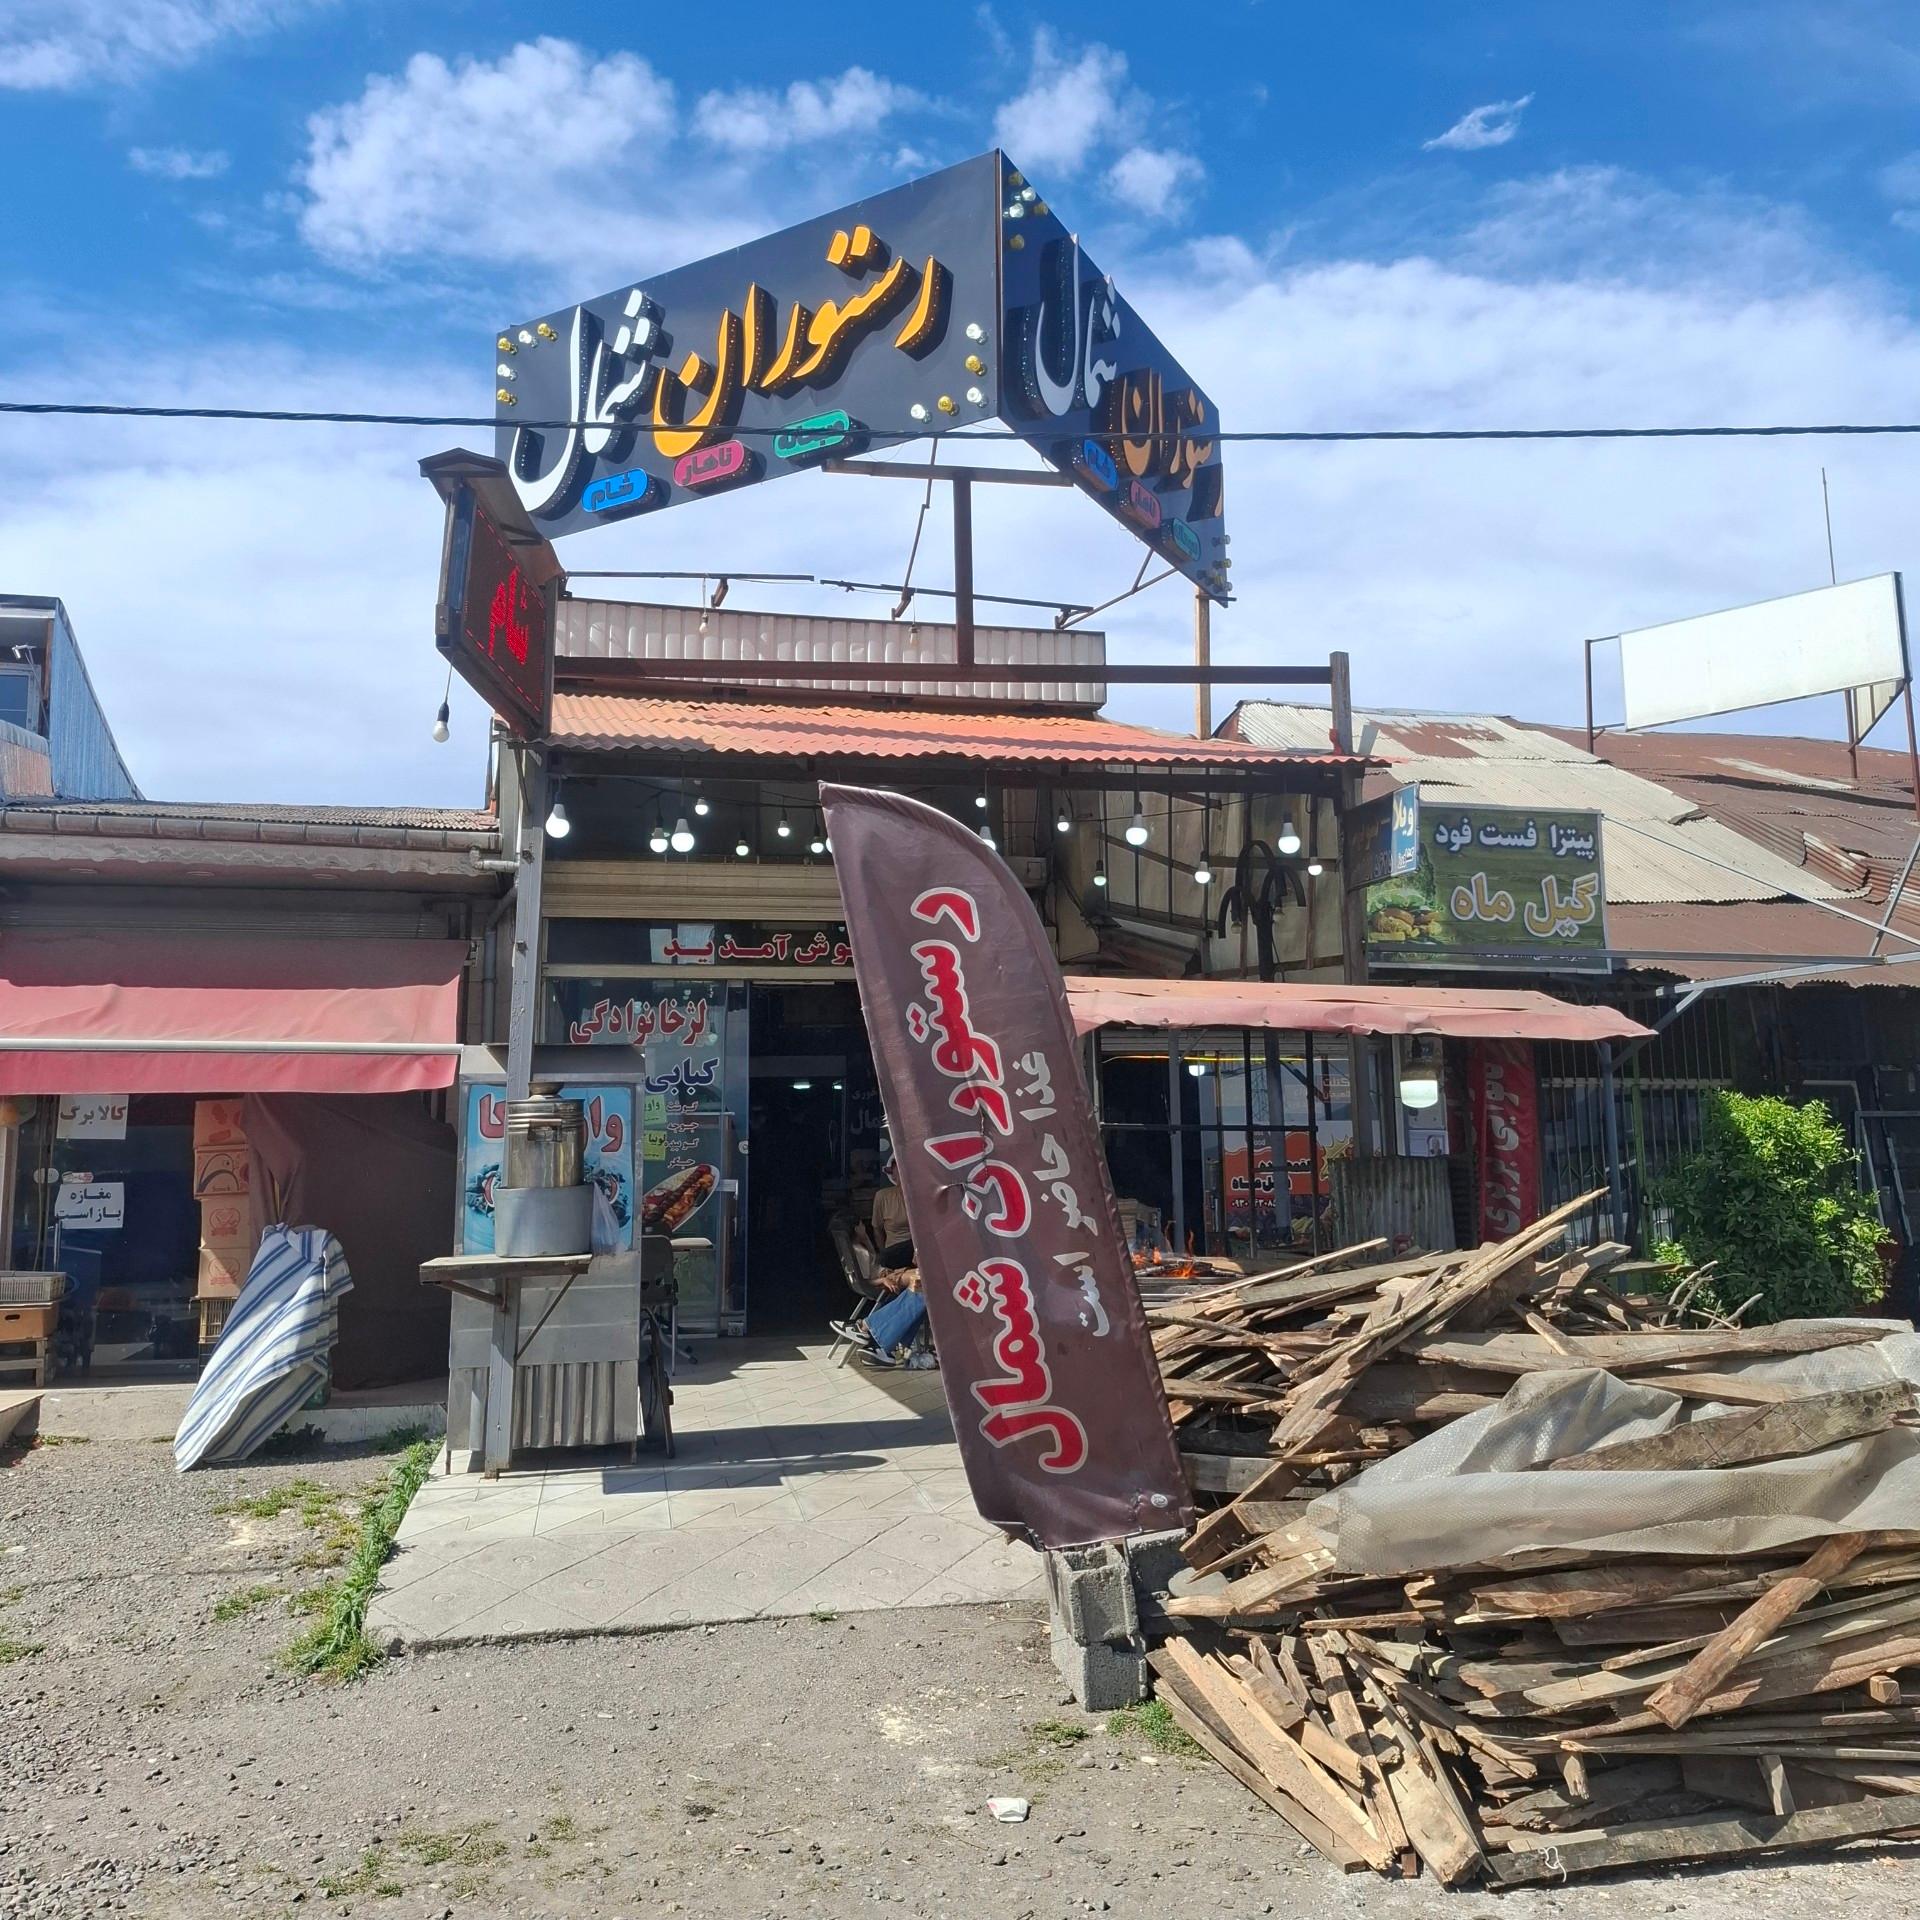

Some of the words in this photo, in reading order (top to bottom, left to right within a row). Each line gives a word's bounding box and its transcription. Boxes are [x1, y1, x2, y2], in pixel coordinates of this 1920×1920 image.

[653, 224, 936, 459] رستوران
[1035, 233, 1121, 417] شمال
[508, 287, 652, 514] شمال
[681, 446, 733, 485] ناهار
[590, 471, 634, 511] شام
[1435, 817, 1473, 851] فود
[1479, 820, 1538, 848] فست
[1551, 824, 1595, 860] پیتزا
[1450, 871, 1516, 922] ماه
[1524, 872, 1599, 938] گیل
[794, 931, 854, 966] وش
[644, 1056, 720, 1096] کبابی
[906, 886, 1032, 1237] رستوران
[1012, 1051, 1058, 1122] غذا
[98, 1105, 127, 1121] کالا
[70, 1187, 112, 1204] مغازه
[1032, 1133, 1099, 1237] حاضر
[95, 1206, 122, 1223] باز
[1052, 1252, 1111, 1337] است
[954, 1256, 1089, 1475] شمال
